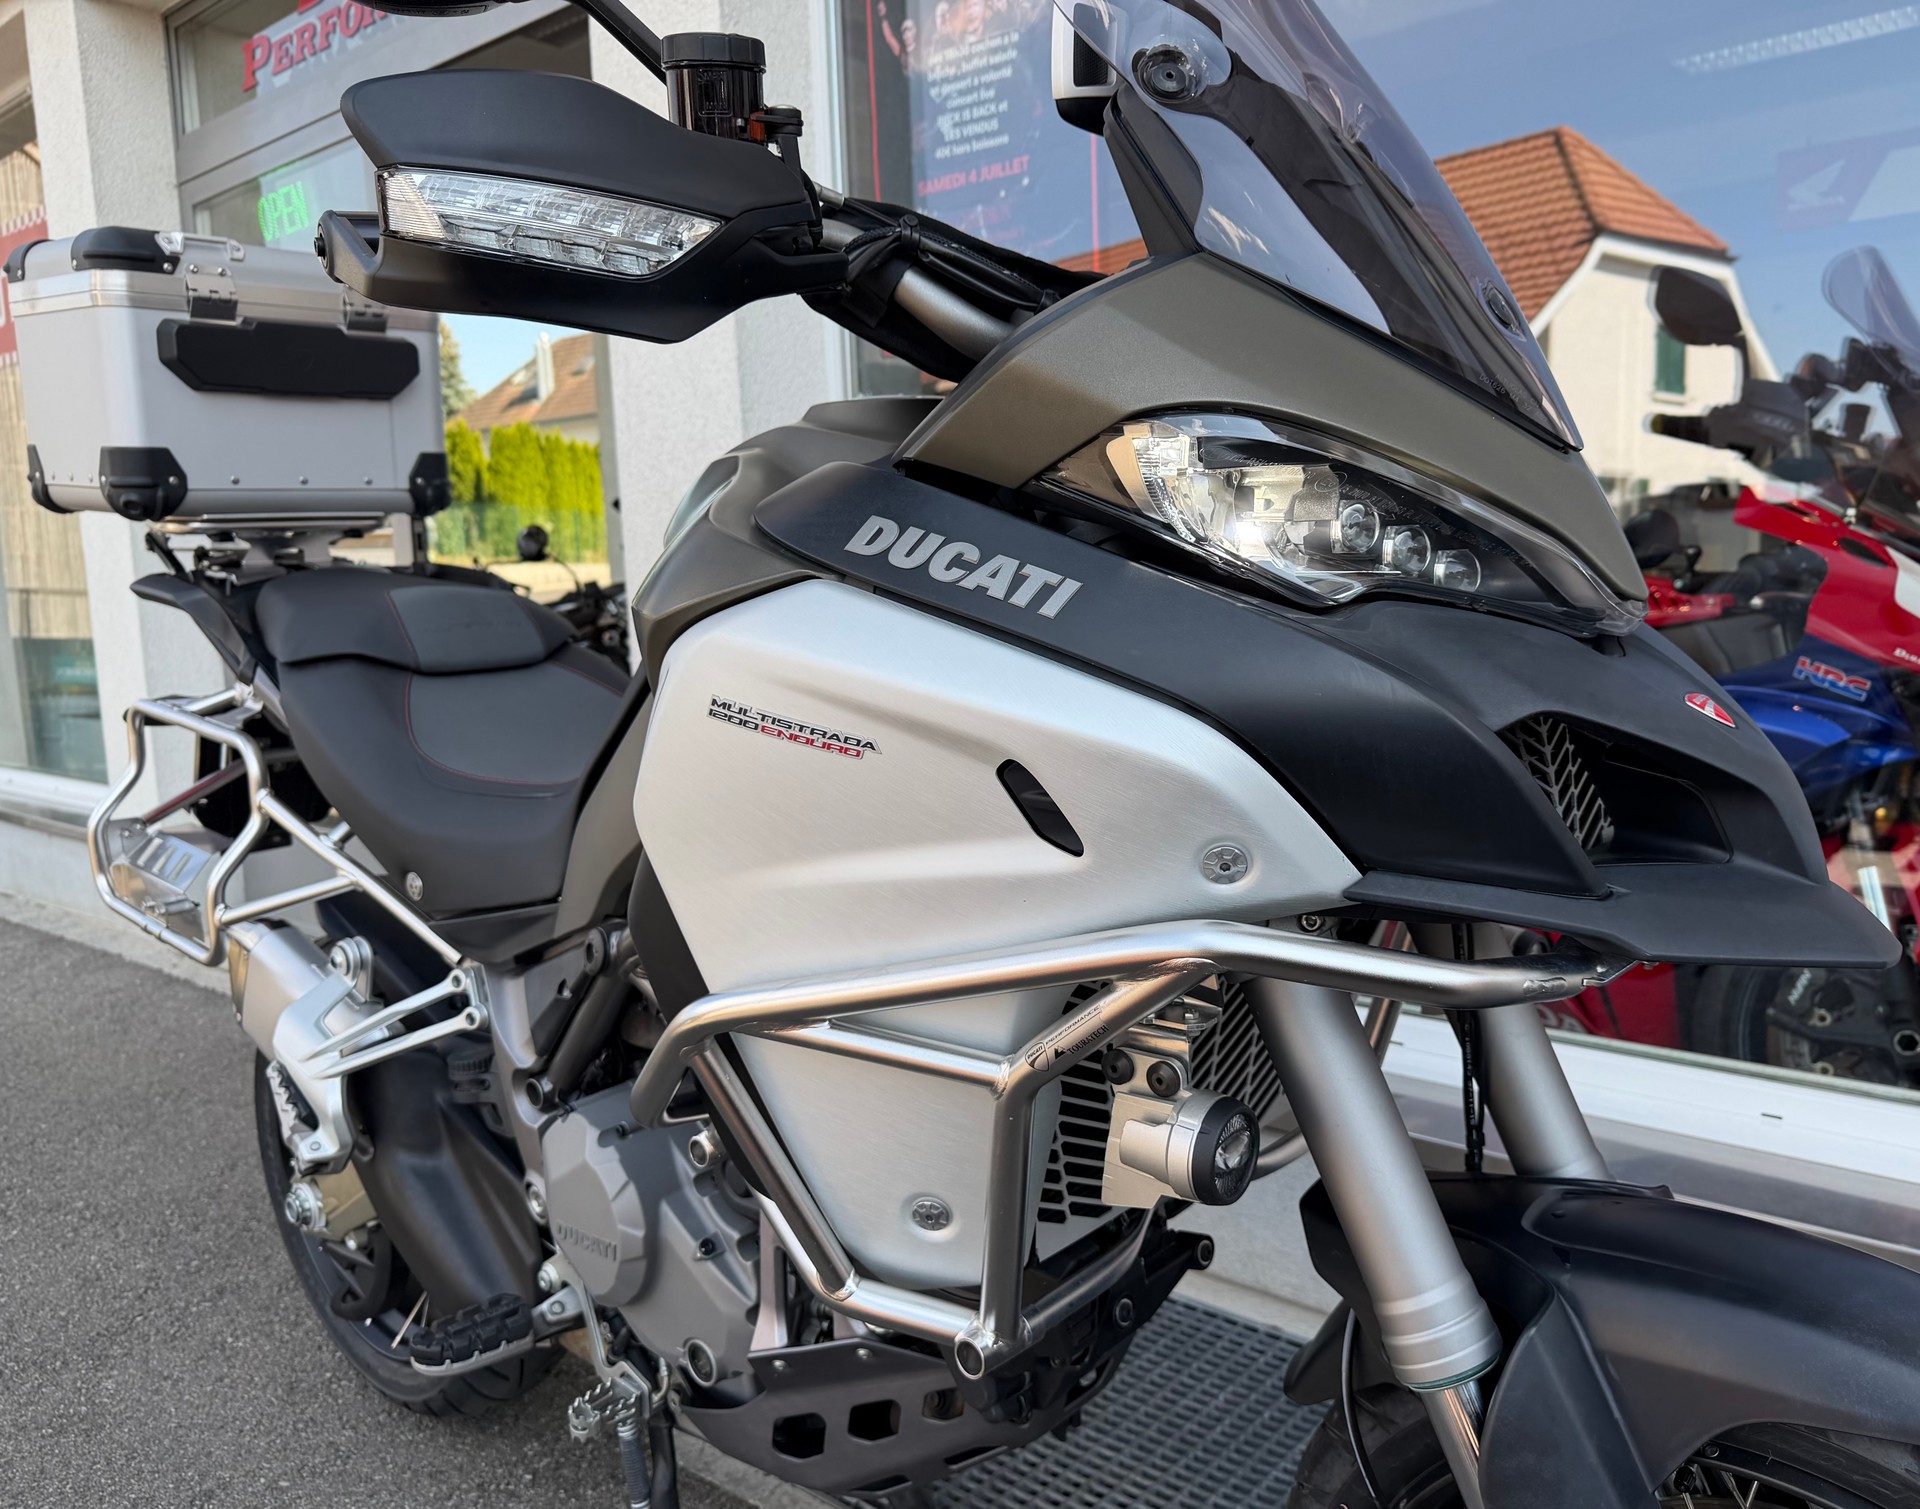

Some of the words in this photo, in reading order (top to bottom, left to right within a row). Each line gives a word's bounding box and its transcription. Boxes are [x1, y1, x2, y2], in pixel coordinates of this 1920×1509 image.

[917, 170, 966, 197] SAMEDI
[968, 166, 977, 184] 4
[979, 154, 1030, 182] JUILLET
[257, 181, 309, 241] OPEN
[844, 514, 1084, 620] DUCATI
[1792, 656, 1871, 702] HRC
[708, 707, 760, 732] 1200
[760, 724, 862, 759] ENDURO
[710, 697, 877, 751] MULTISTRADA
[1045, 1004, 1101, 1046] PERFORMANCE
[1066, 1024, 1110, 1055] TOURATECH
[556, 1220, 618, 1262] DUCATI
